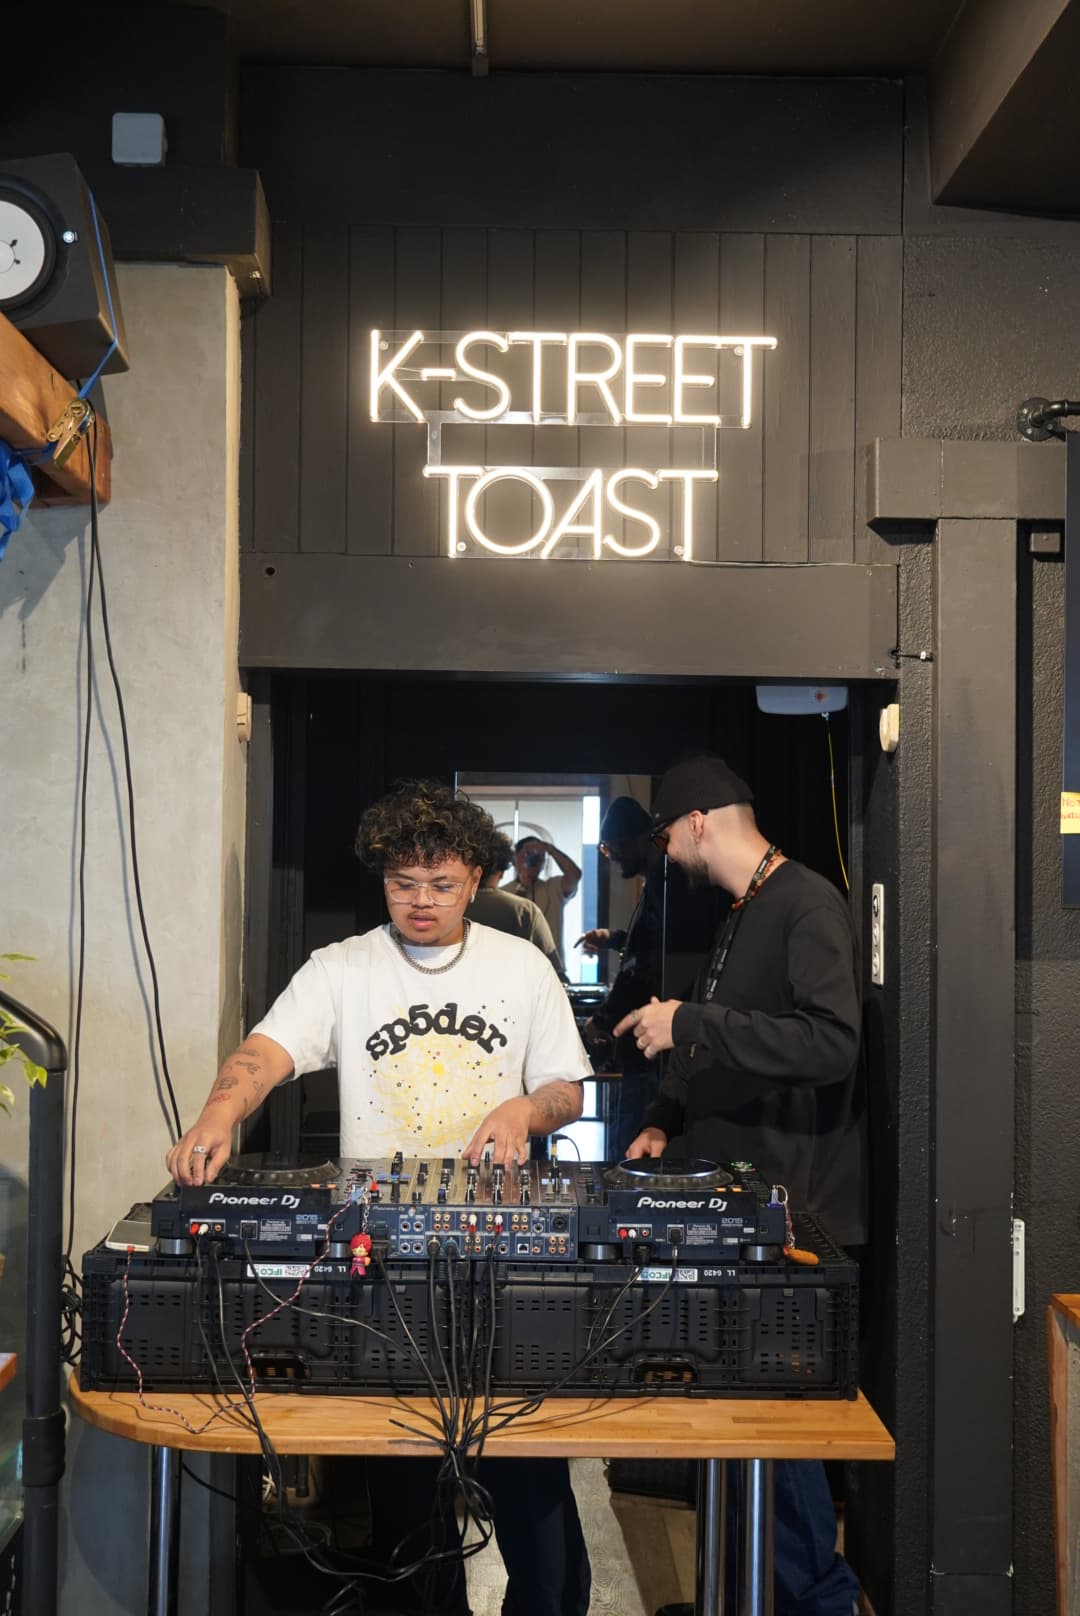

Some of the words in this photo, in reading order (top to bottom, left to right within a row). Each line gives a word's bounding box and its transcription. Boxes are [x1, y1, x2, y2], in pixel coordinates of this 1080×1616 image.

[369, 329, 777, 428] K-STREET
[422, 466, 719, 560] TOAST
[208, 1192, 278, 1205] Pioneer
[637, 1196, 705, 1209] Pioneer
[260, 1268, 283, 1276] IFCO
[703, 1269, 722, 1277] 6420
[726, 1269, 736, 1277] LL
